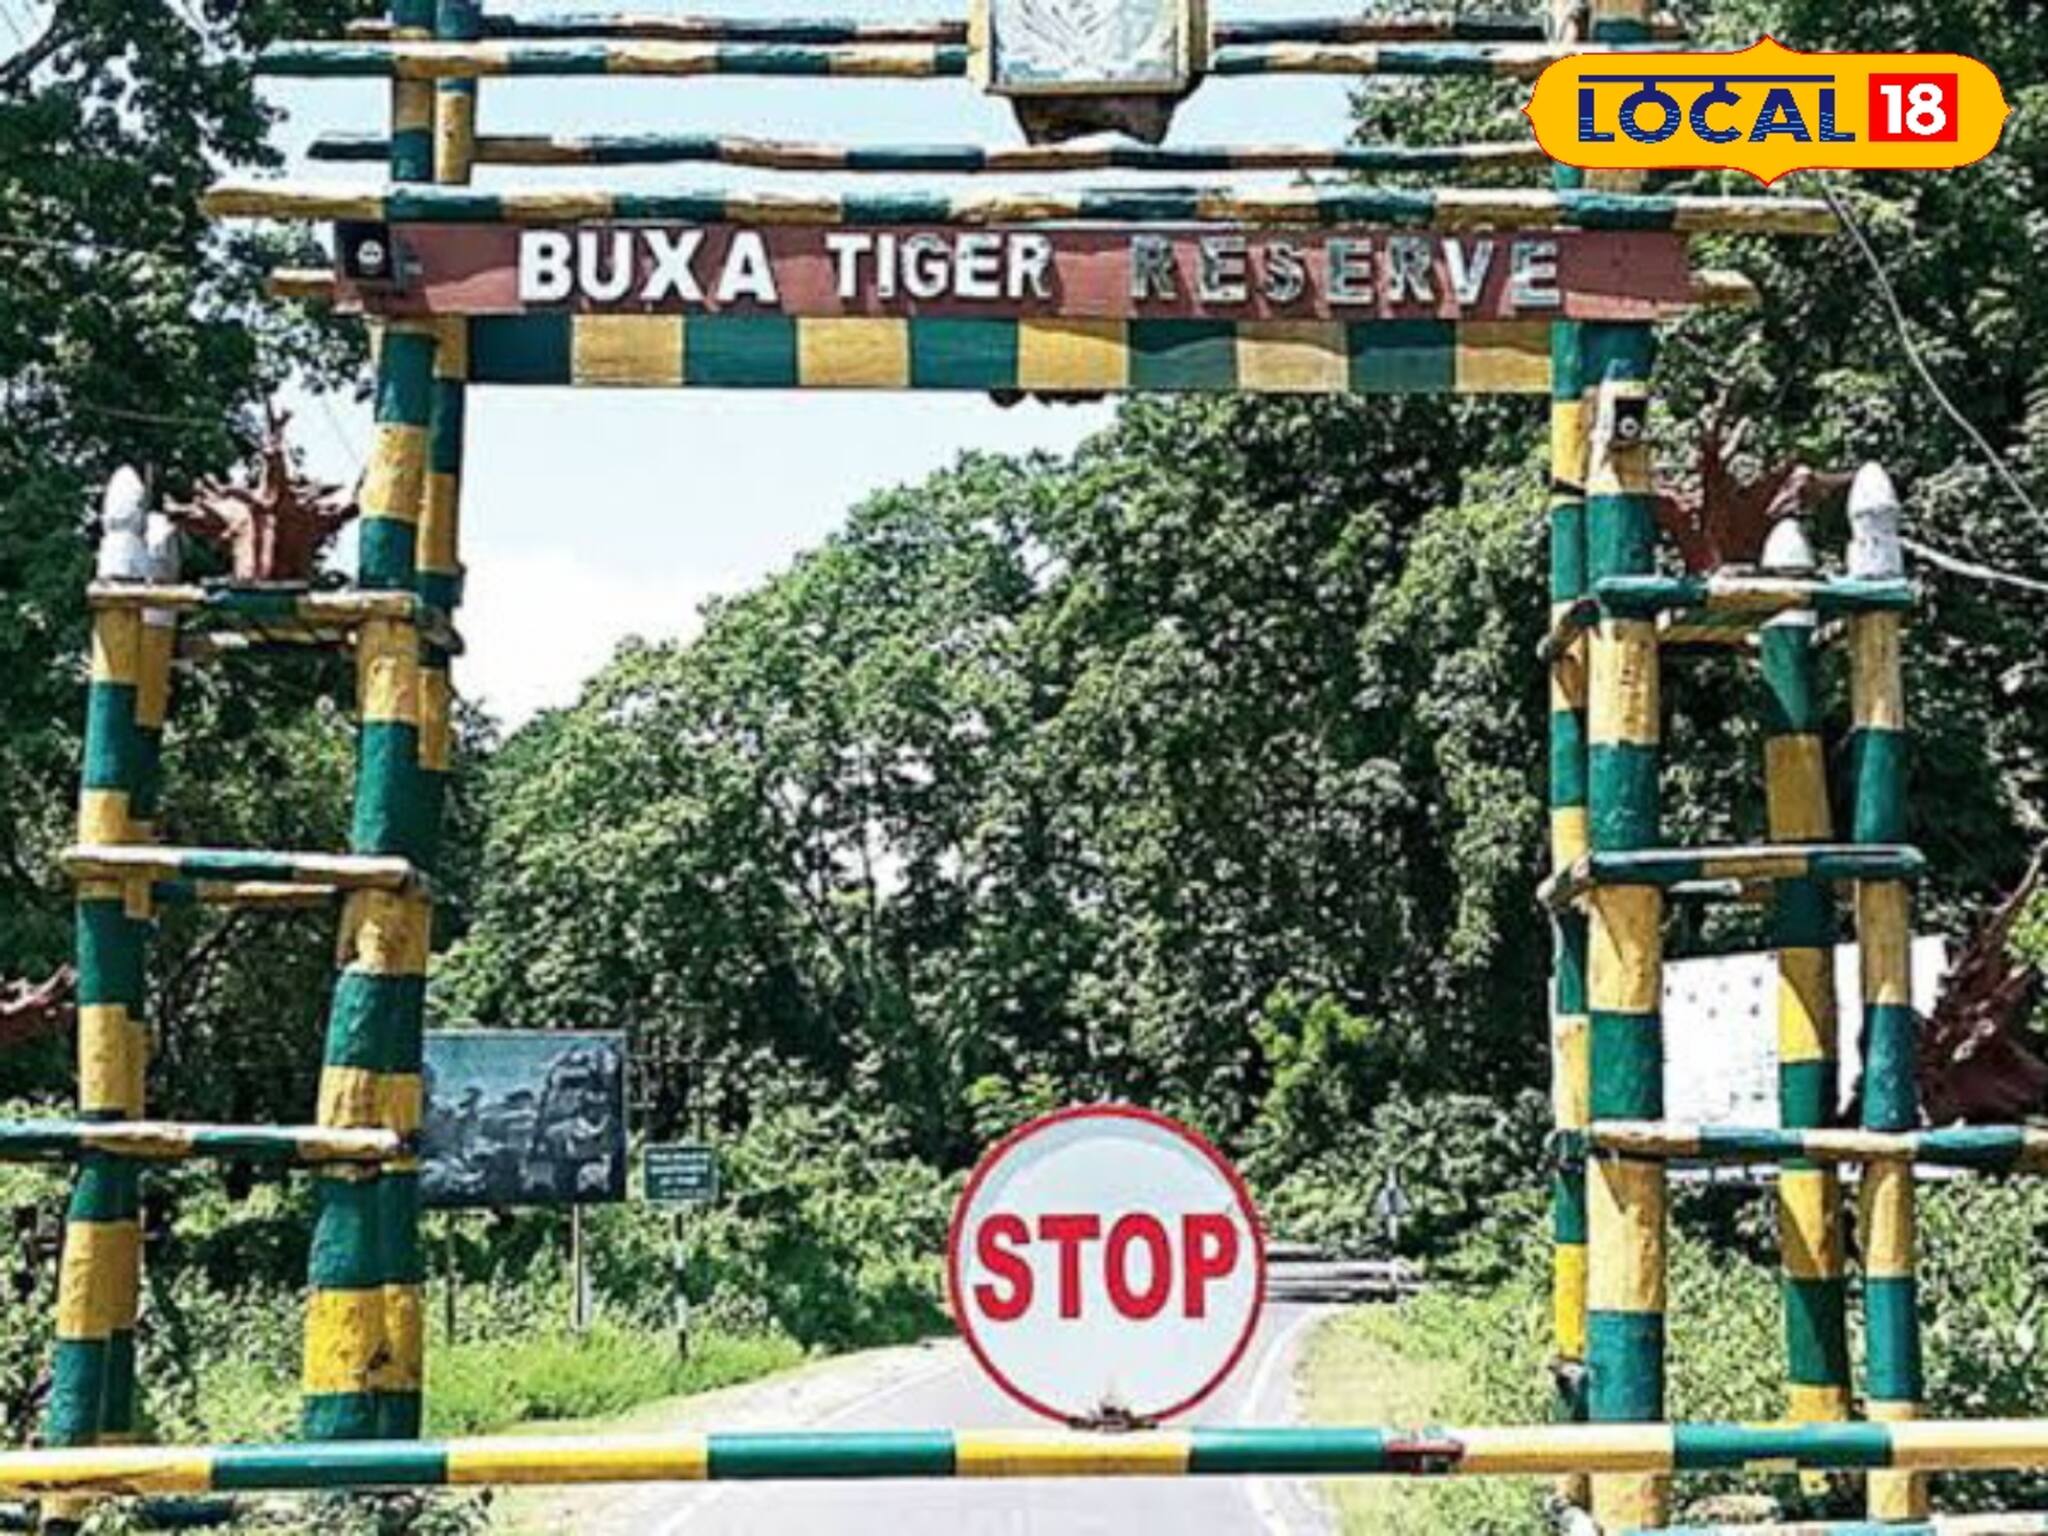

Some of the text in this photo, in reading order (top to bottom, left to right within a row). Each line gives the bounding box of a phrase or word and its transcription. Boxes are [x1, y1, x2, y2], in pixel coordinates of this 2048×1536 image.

[518, 228, 1561, 306] BUXA TIGER RESERVE
[973, 1212, 1239, 1322] STOP
